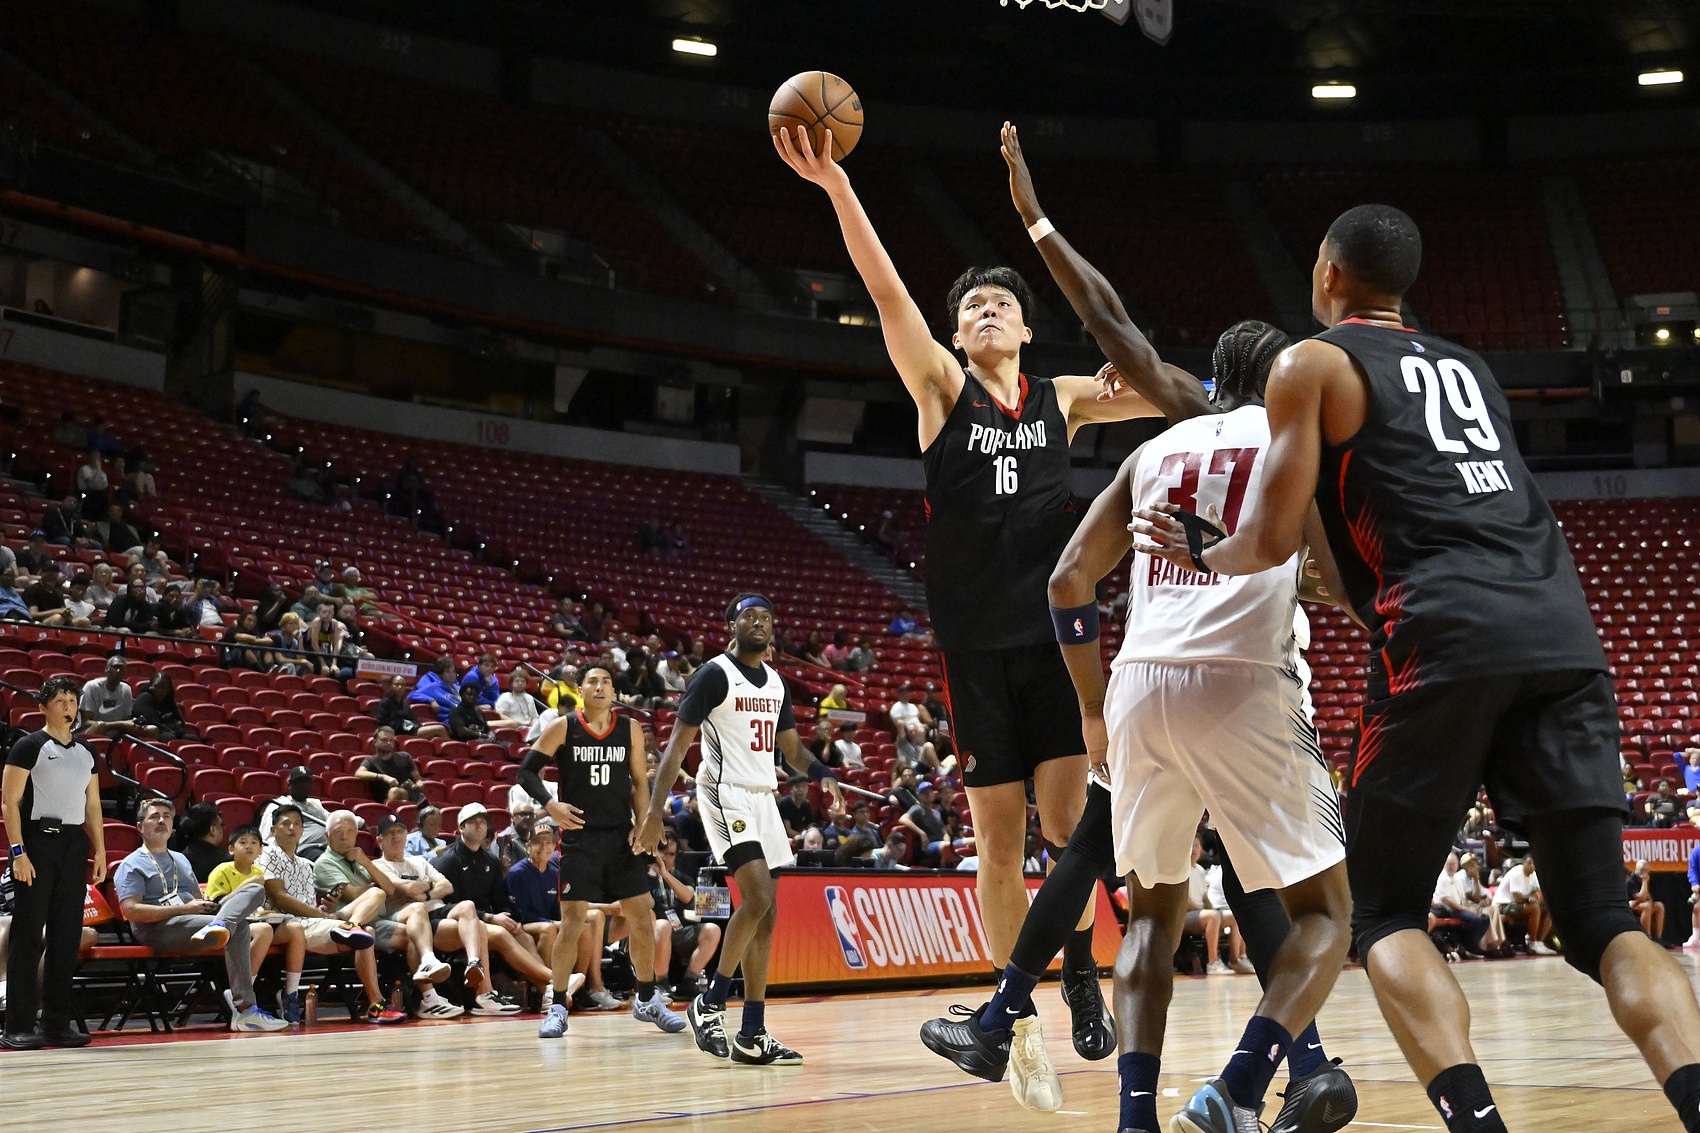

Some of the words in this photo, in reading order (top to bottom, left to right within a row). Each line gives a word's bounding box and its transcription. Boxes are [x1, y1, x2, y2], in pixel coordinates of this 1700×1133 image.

[381, 31, 412, 55] 212
[1400, 355, 1500, 454] 29
[476, 421, 509, 445] 108
[967, 420, 1047, 456] PORLAND
[993, 455, 1018, 494] 16
[1454, 460, 1514, 494] KENT
[1594, 475, 1626, 496] 110
[1150, 447, 1260, 547] 37
[735, 697, 782, 714] NUGGETS
[750, 719, 774, 753] 30
[573, 746, 626, 763] PORTLAND
[590, 764, 610, 786] 50
[1623, 839, 1679, 863] SUMMER
[853, 887, 980, 967] SUMMER
